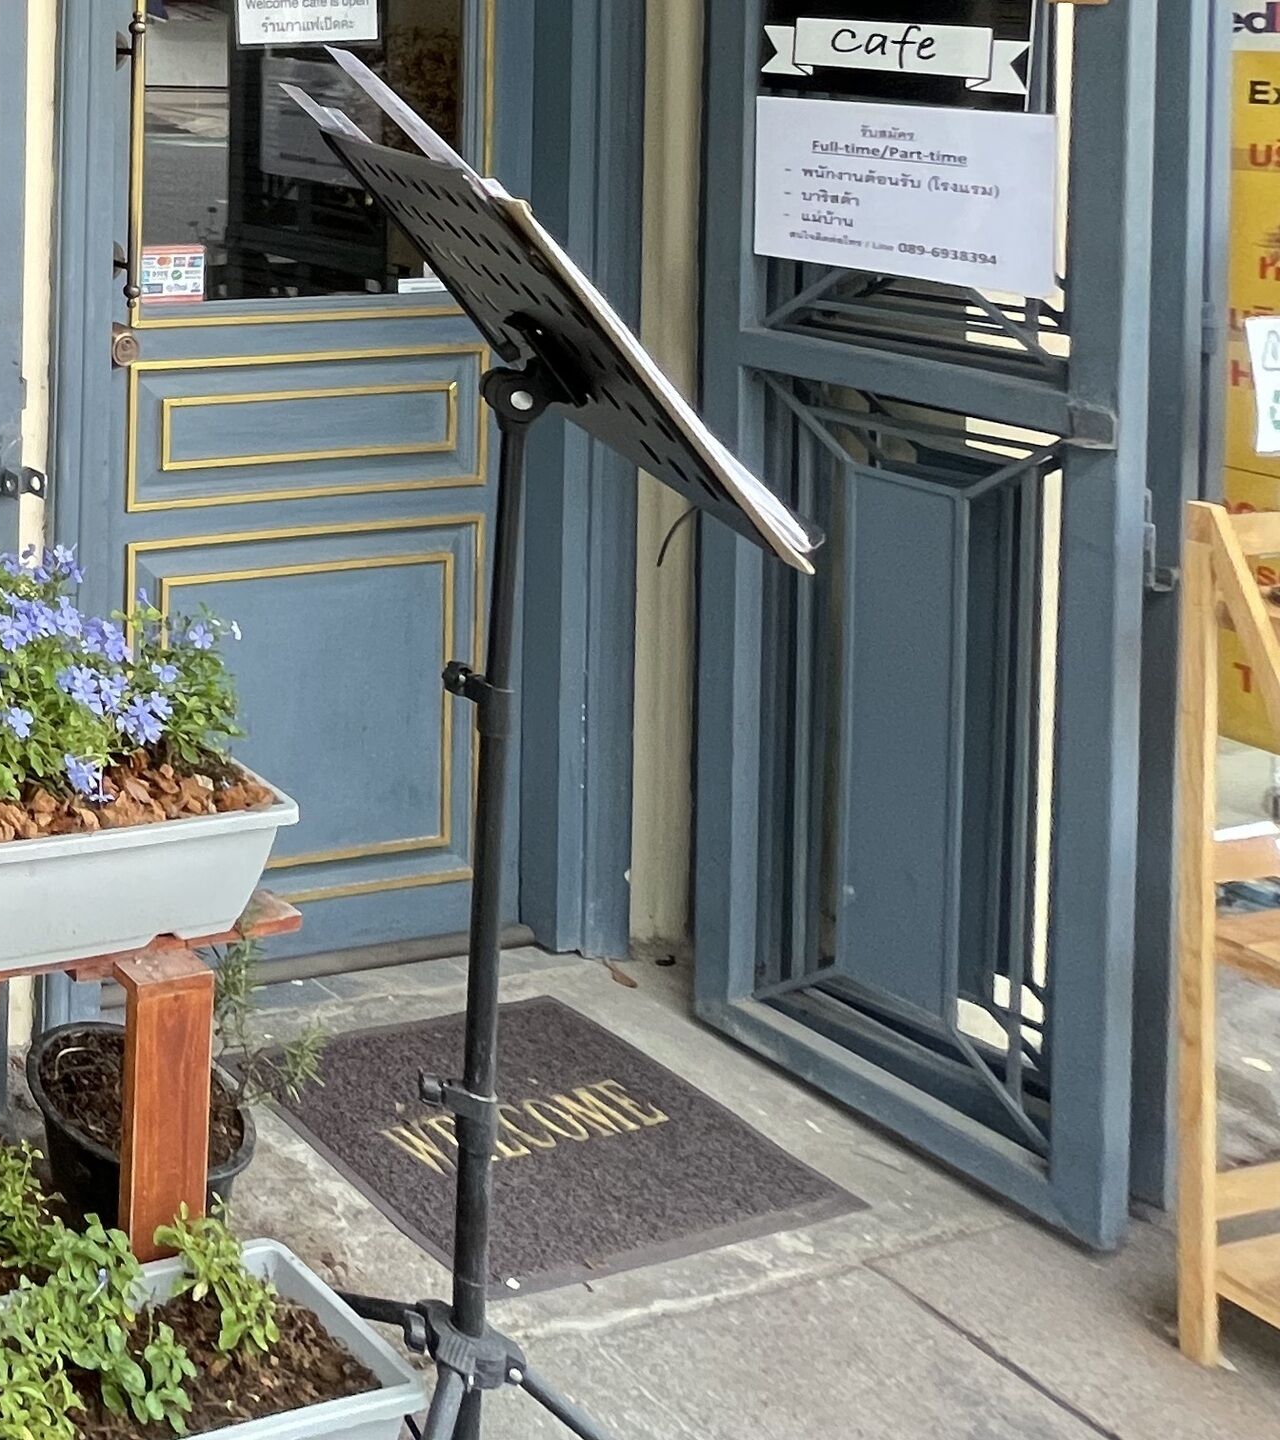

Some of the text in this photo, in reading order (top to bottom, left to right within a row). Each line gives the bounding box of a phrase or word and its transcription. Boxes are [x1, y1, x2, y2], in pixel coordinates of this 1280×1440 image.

[811, 140, 969, 166] Full-time/Part-time
[801, 165, 1001, 199] พนักงานต้อนรับ (โรงแรม)
